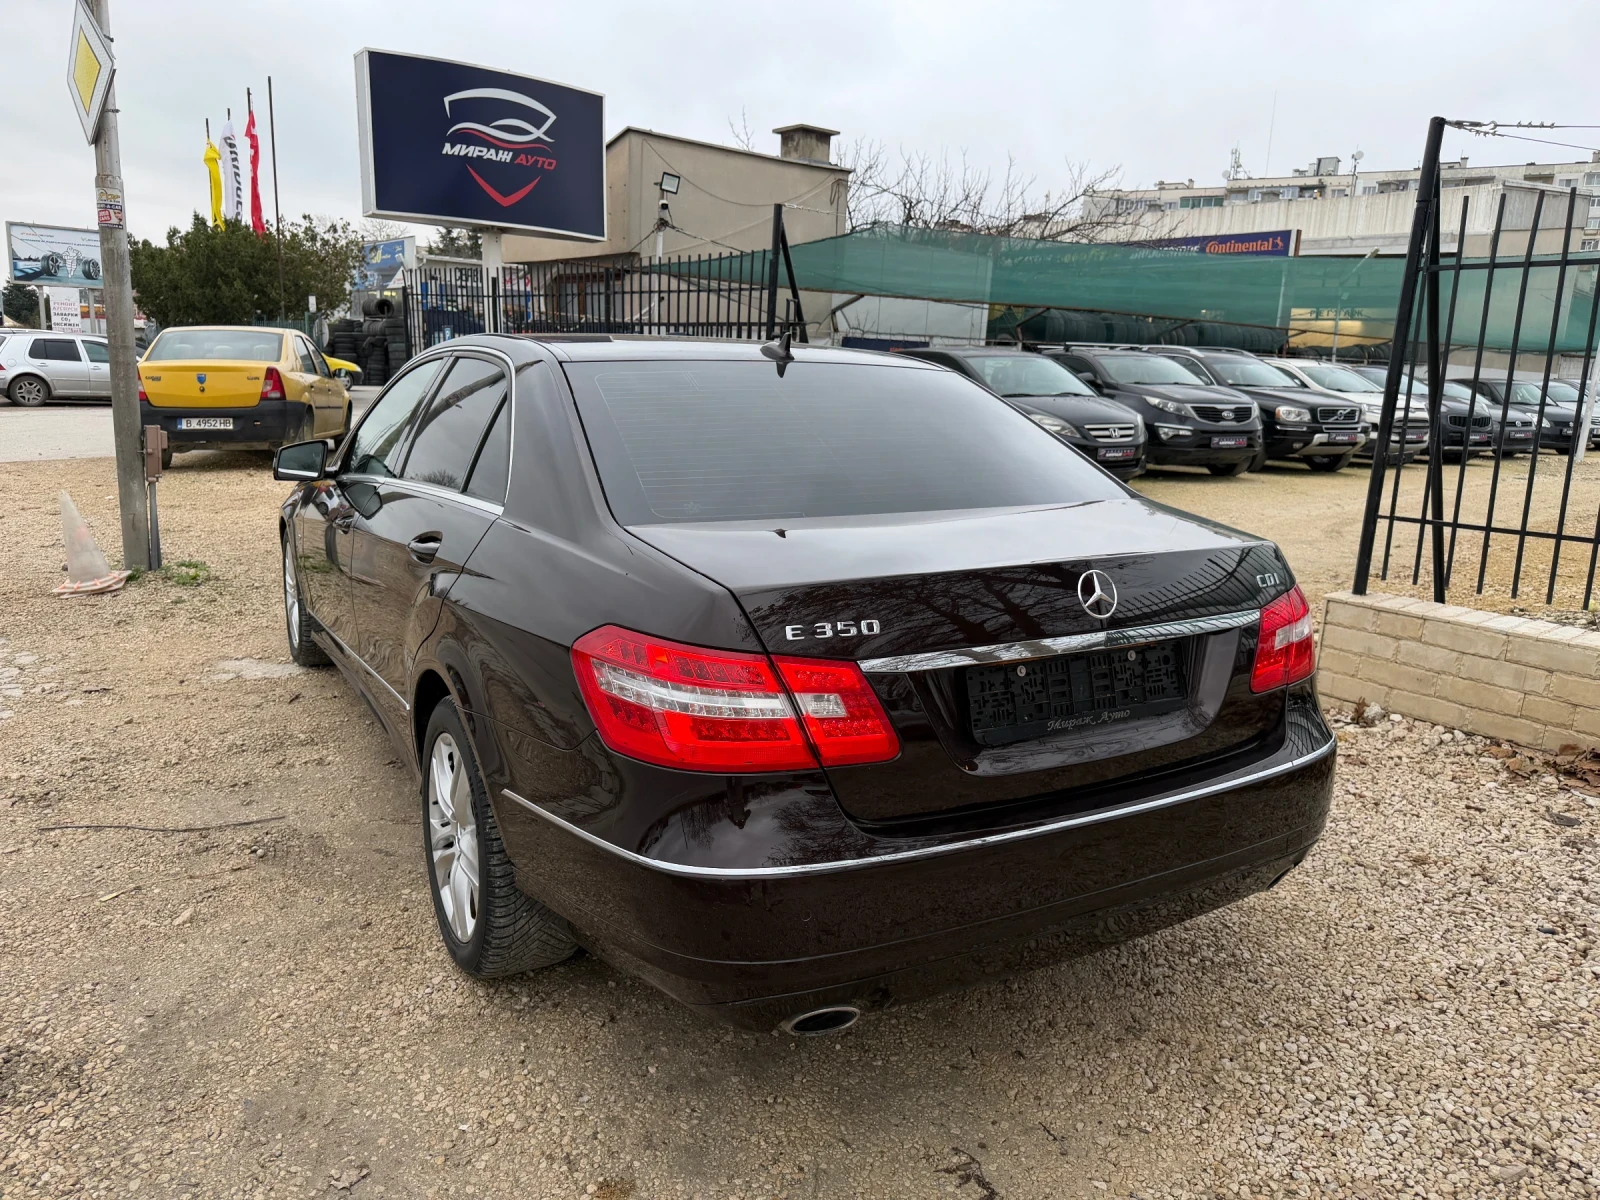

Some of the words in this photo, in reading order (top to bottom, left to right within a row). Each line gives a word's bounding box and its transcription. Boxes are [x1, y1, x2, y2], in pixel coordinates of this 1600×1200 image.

[442, 142, 513, 163] МИРАЖ
[514, 153, 557, 170] АУТО
[1206, 238, 1273, 254] Continental
[1256, 572, 1280, 587] CDI
[785, 624, 805, 641] E
[813, 619, 881, 639] 350
[1047, 715, 1096, 731] Мираж
[1097, 709, 1131, 724] Ауто
